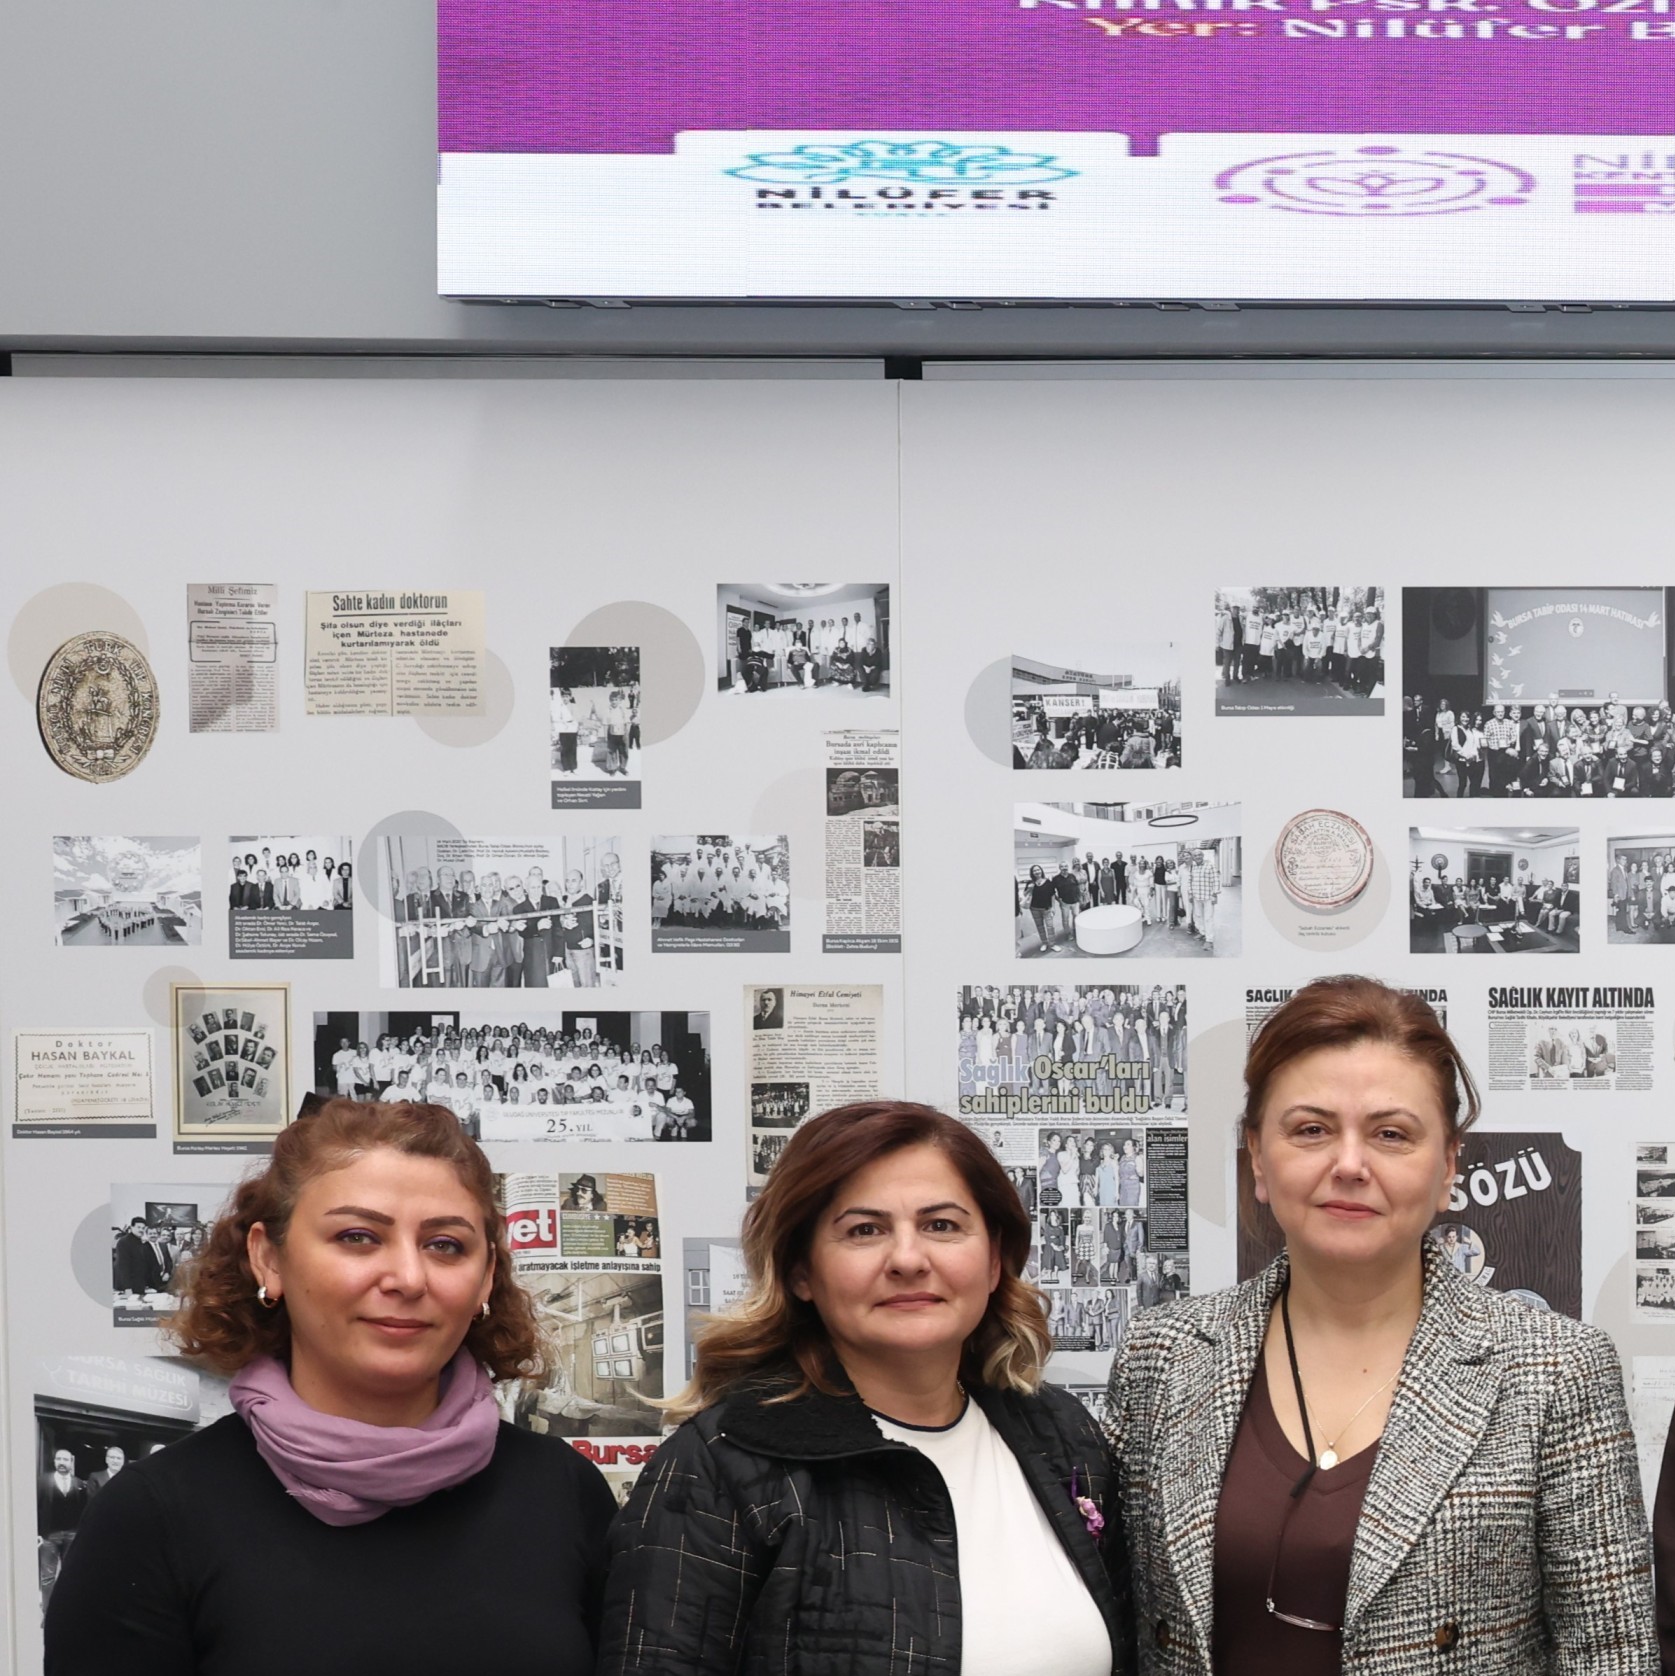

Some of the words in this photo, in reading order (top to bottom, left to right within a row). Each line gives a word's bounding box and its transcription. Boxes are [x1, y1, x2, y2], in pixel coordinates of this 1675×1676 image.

[1084, 16, 1261, 37] Yer:
[1281, 18, 1607, 39] Nilüfer
[755, 186, 1058, 200] NİLÜFER
[332, 594, 363, 612] Sahte
[366, 593, 396, 611] kadın
[399, 593, 448, 610] doktorun
[320, 620, 339, 631] Şifa
[340, 620, 366, 630] olsun
[369, 620, 389, 631] diye
[393, 619, 427, 631] verdiği
[332, 630, 352, 640] içen
[357, 629, 394, 639] Mürteza
[419, 637, 440, 648] öldü
[1488, 985, 1546, 1009] SAĞLIK
[1546, 986, 1590, 1009] KAYIT
[1592, 986, 1656, 1009] ALTINDA
[55, 1039, 113, 1049] Doktor
[31, 1050, 78, 1062] HASAN
[82, 1049, 136, 1062] BAYKAL
[957, 1054, 1031, 1089] Sağlık
[958, 1087, 1081, 1120] sahiplerini
[1084, 1086, 1151, 1115] buldu
[546, 1118, 574, 1134] 25.
[576, 1123, 593, 1132] YIL
[1448, 1146, 1553, 1213] SÖZÜ
[518, 1260, 569, 1272] aratmayacak
[570, 1260, 600, 1271] işletme
[641, 1262, 661, 1273] sahip
[133, 1362, 187, 1386] SAĞLIK
